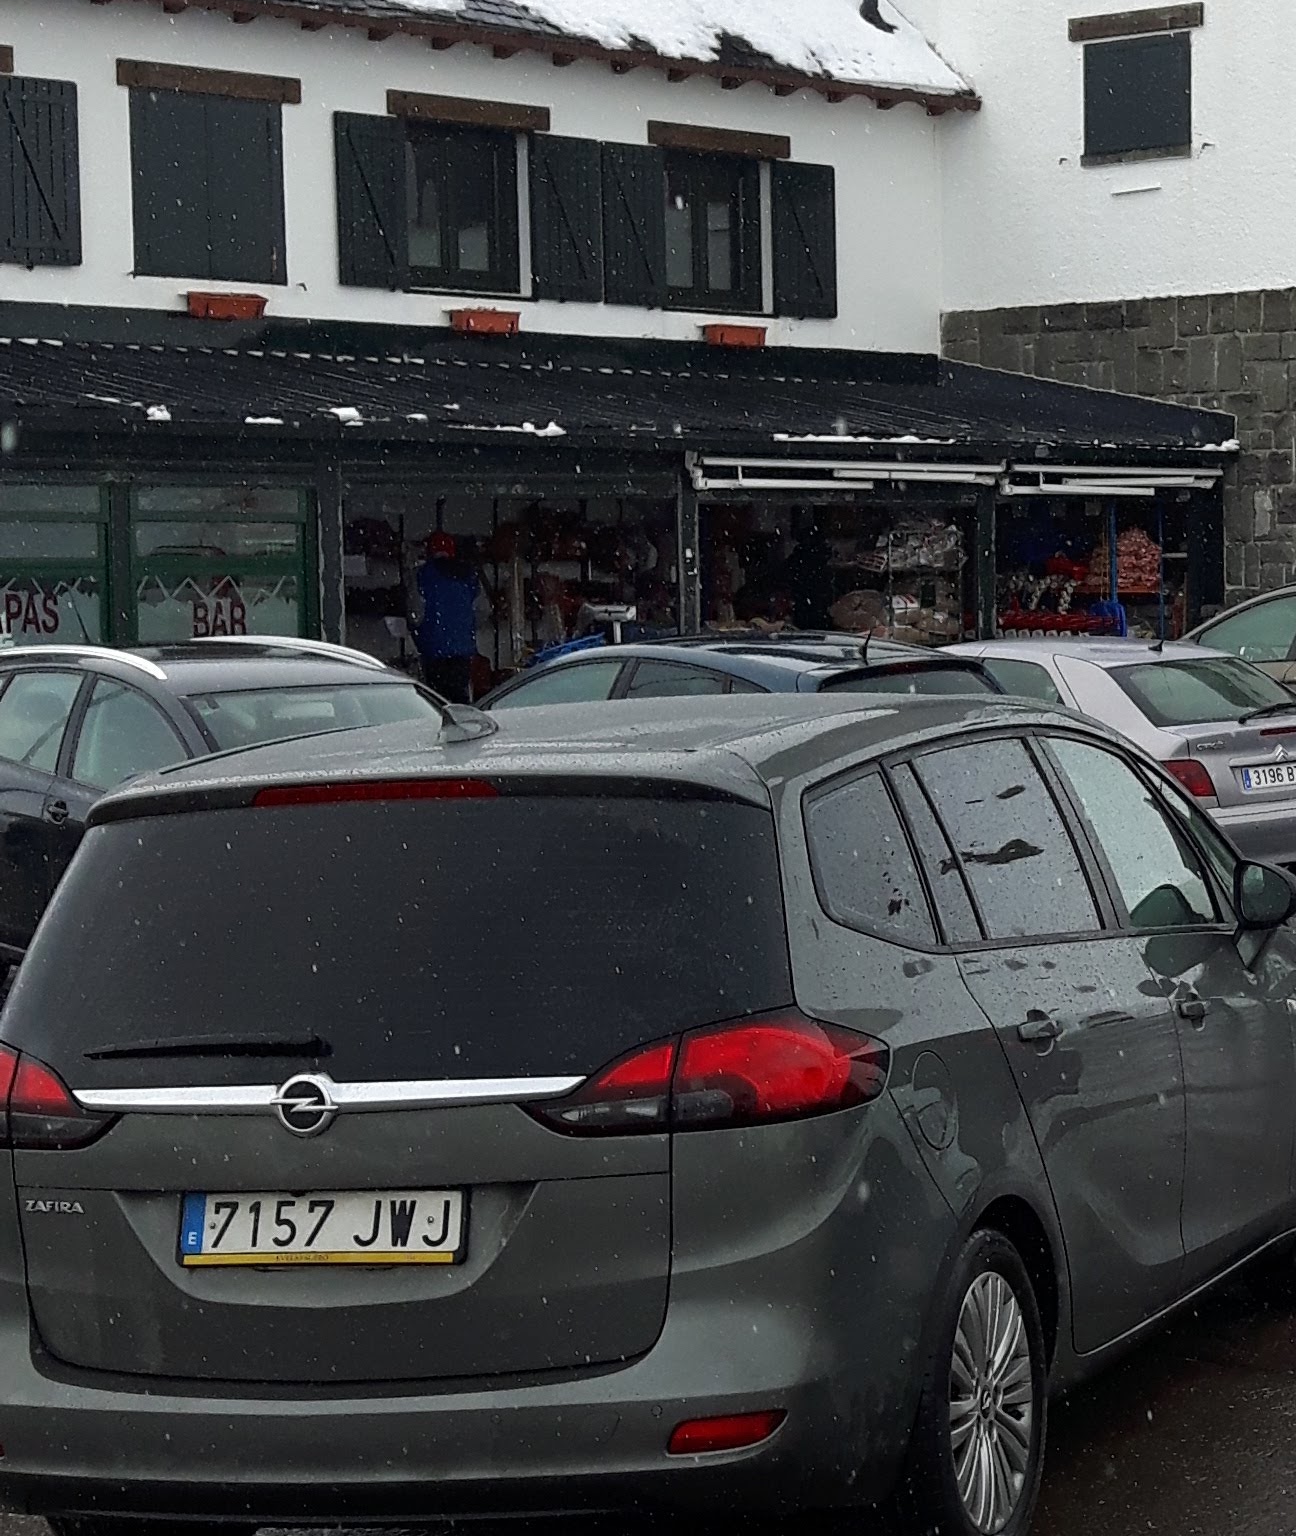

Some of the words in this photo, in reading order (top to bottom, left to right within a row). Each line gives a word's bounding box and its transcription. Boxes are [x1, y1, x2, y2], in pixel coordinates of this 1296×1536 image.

[0, 593, 59, 634] PAS
[193, 599, 247, 637] BAR
[1254, 767, 1284, 785] 3196
[26, 1200, 84, 1213] ZAFIRA
[211, 1200, 335, 1248] 7157
[353, 1199, 451, 1247] JWJ
[188, 1231, 198, 1245] E
